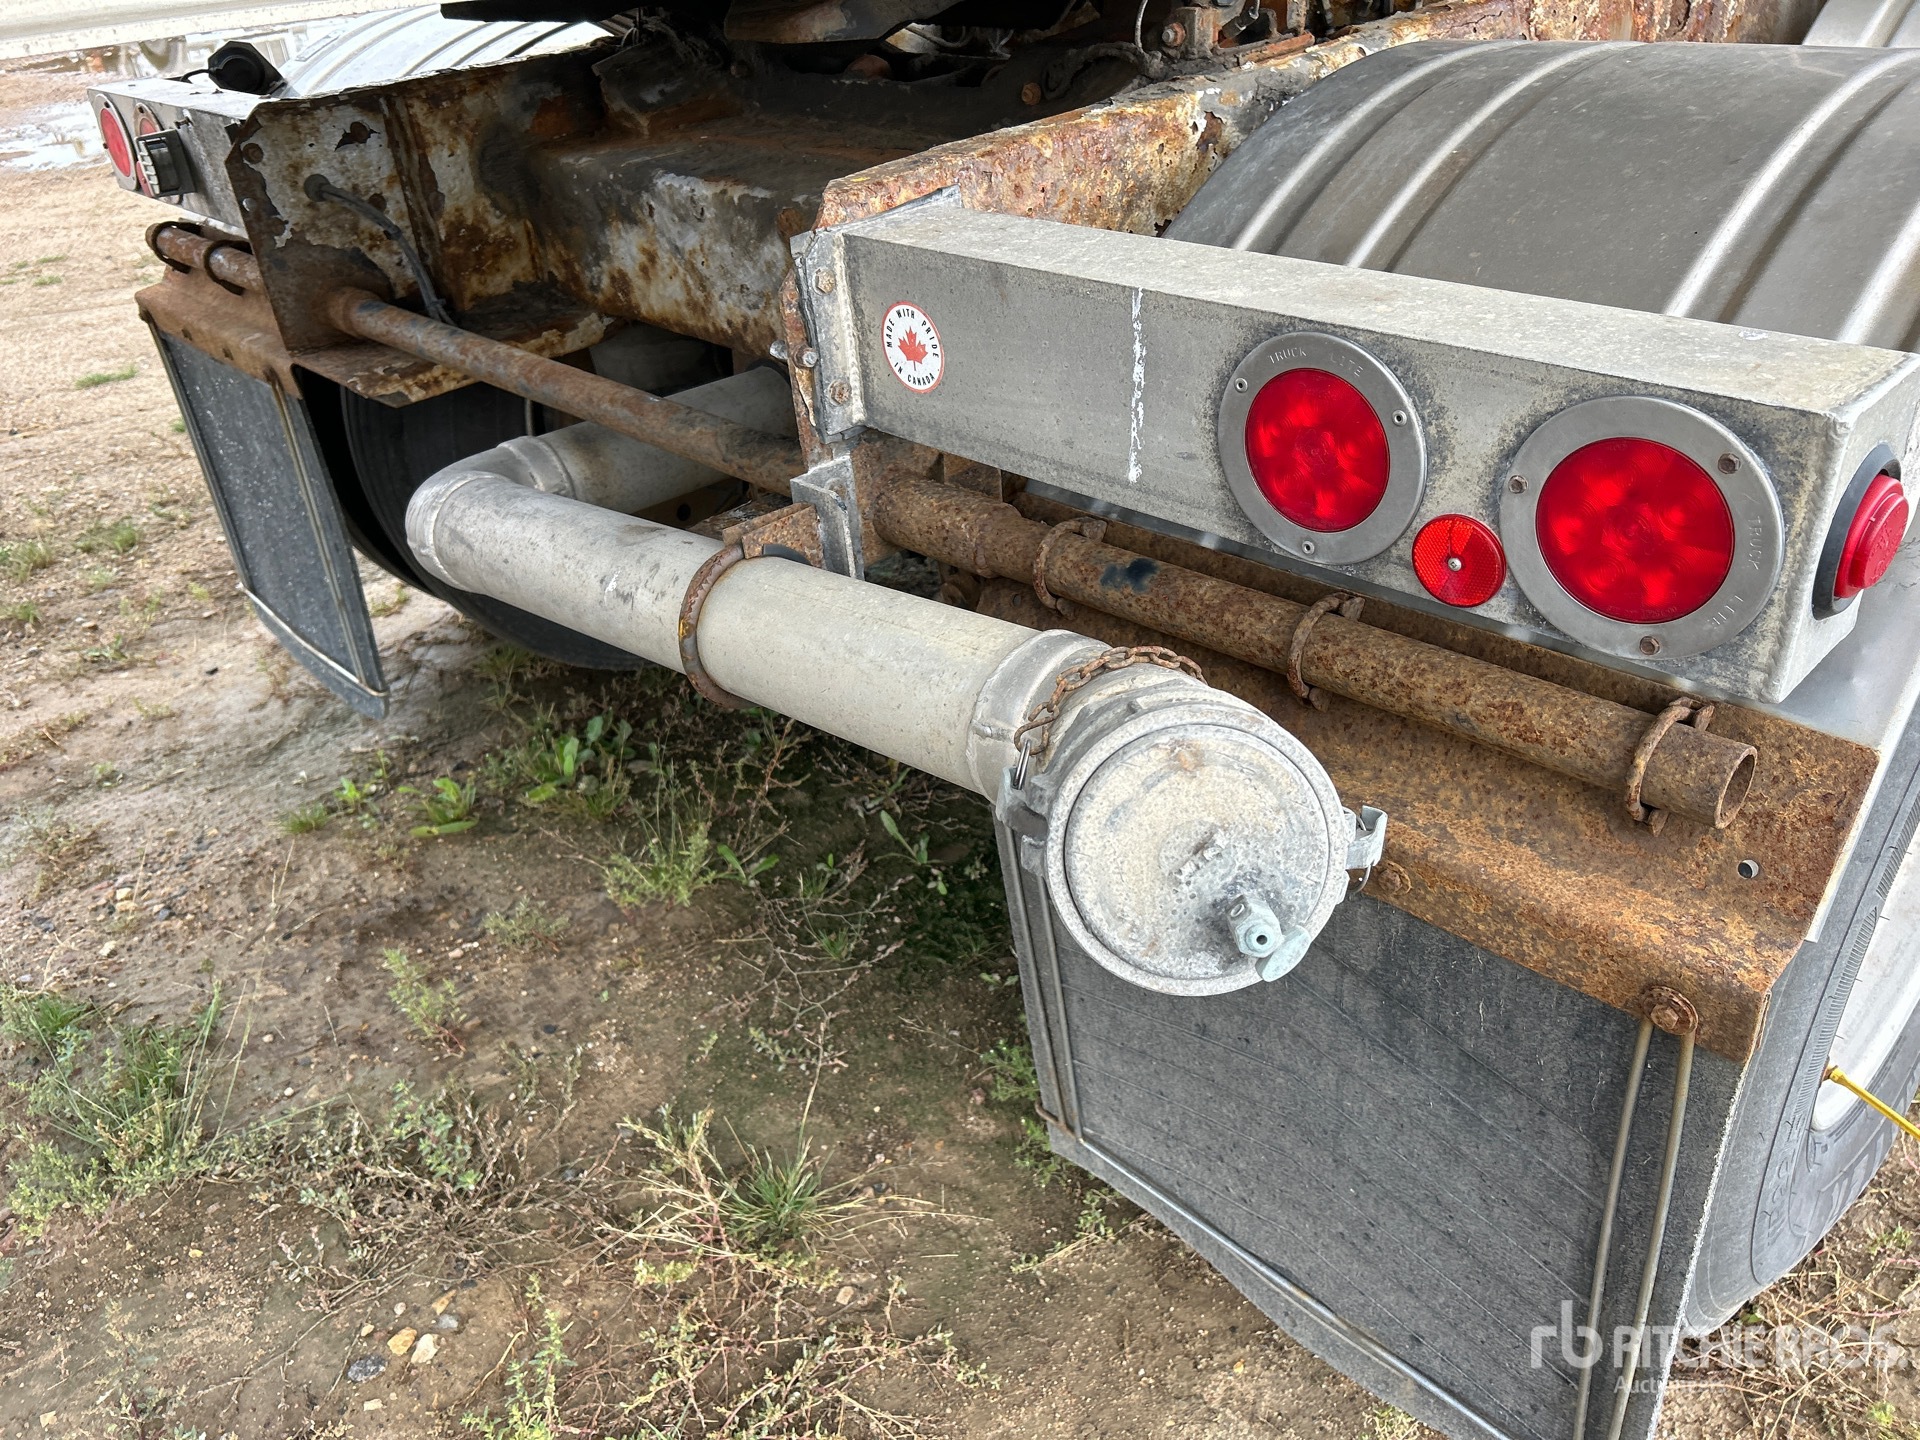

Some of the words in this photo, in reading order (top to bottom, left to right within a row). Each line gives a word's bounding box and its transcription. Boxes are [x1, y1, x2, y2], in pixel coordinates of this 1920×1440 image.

[885, 319, 895, 348] MADE
[896, 308, 915, 319] WITH
[921, 320, 940, 358] PRIDE
[893, 362, 903, 374] IN
[907, 373, 935, 386] CANADA
[1268, 347, 1307, 364] TRUCK
[1748, 515, 1762, 570] TRUCK
